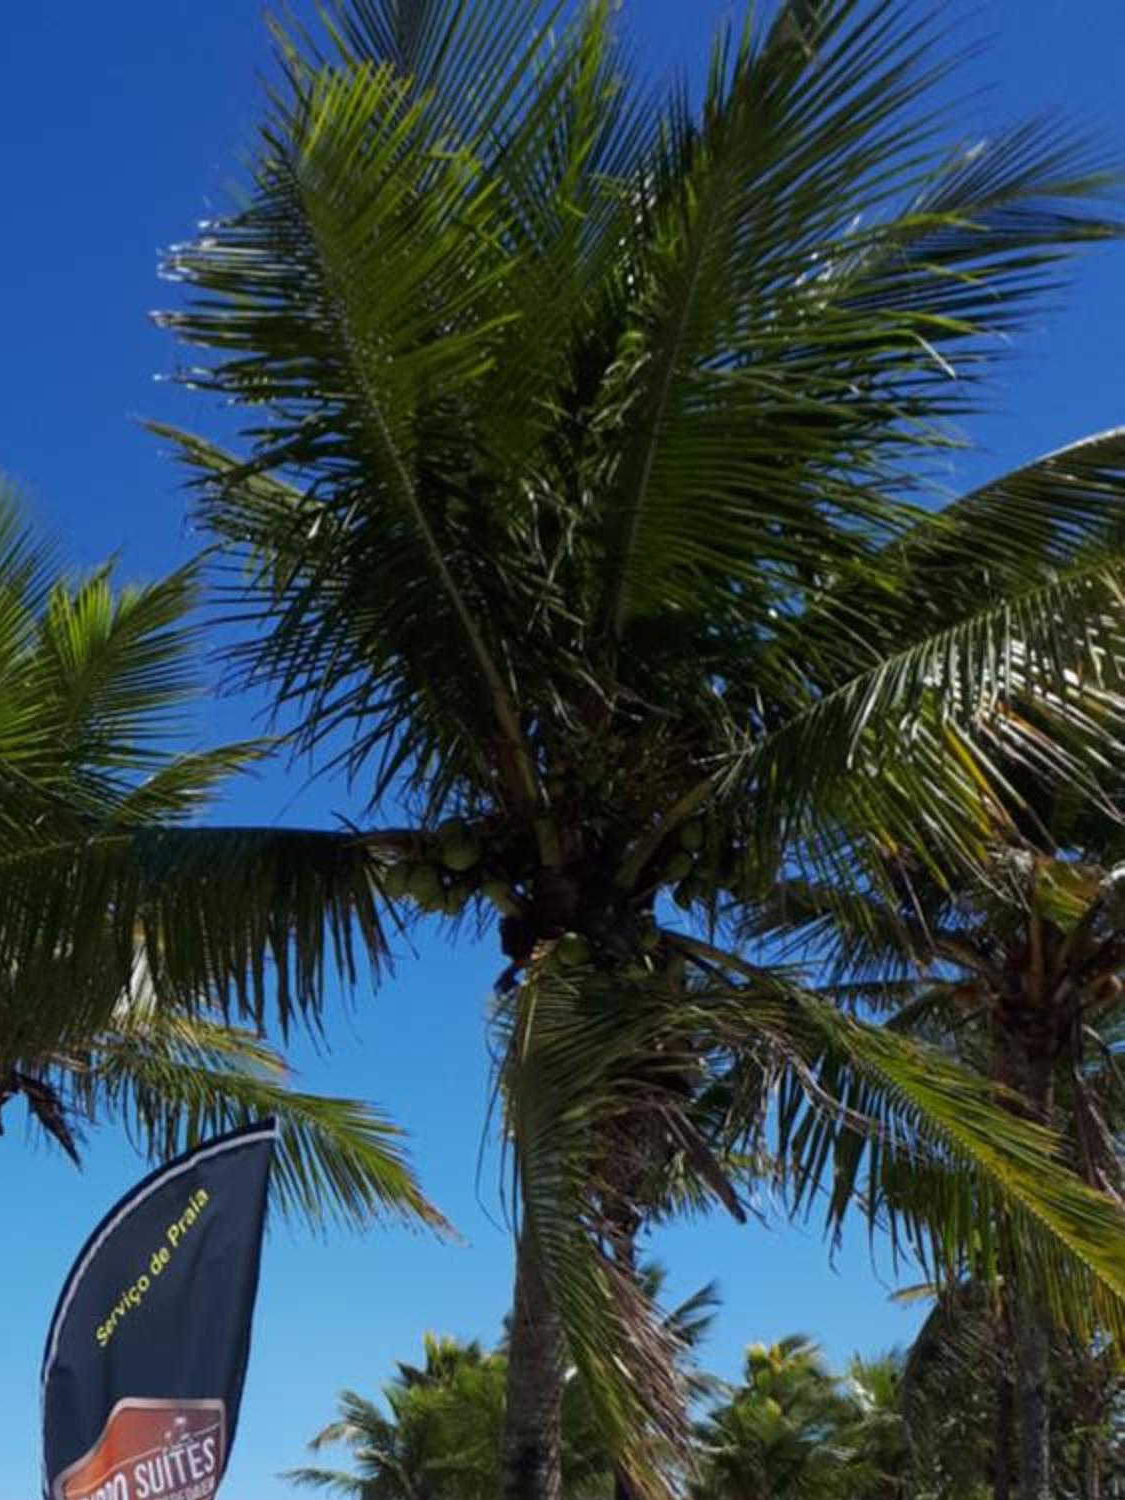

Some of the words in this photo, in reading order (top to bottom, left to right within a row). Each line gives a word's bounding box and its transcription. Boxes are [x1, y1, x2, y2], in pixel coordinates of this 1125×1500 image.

[96, 1274, 151, 1347] Serviço
[150, 1247, 171, 1275] de
[167, 1189, 209, 1247] Praia
